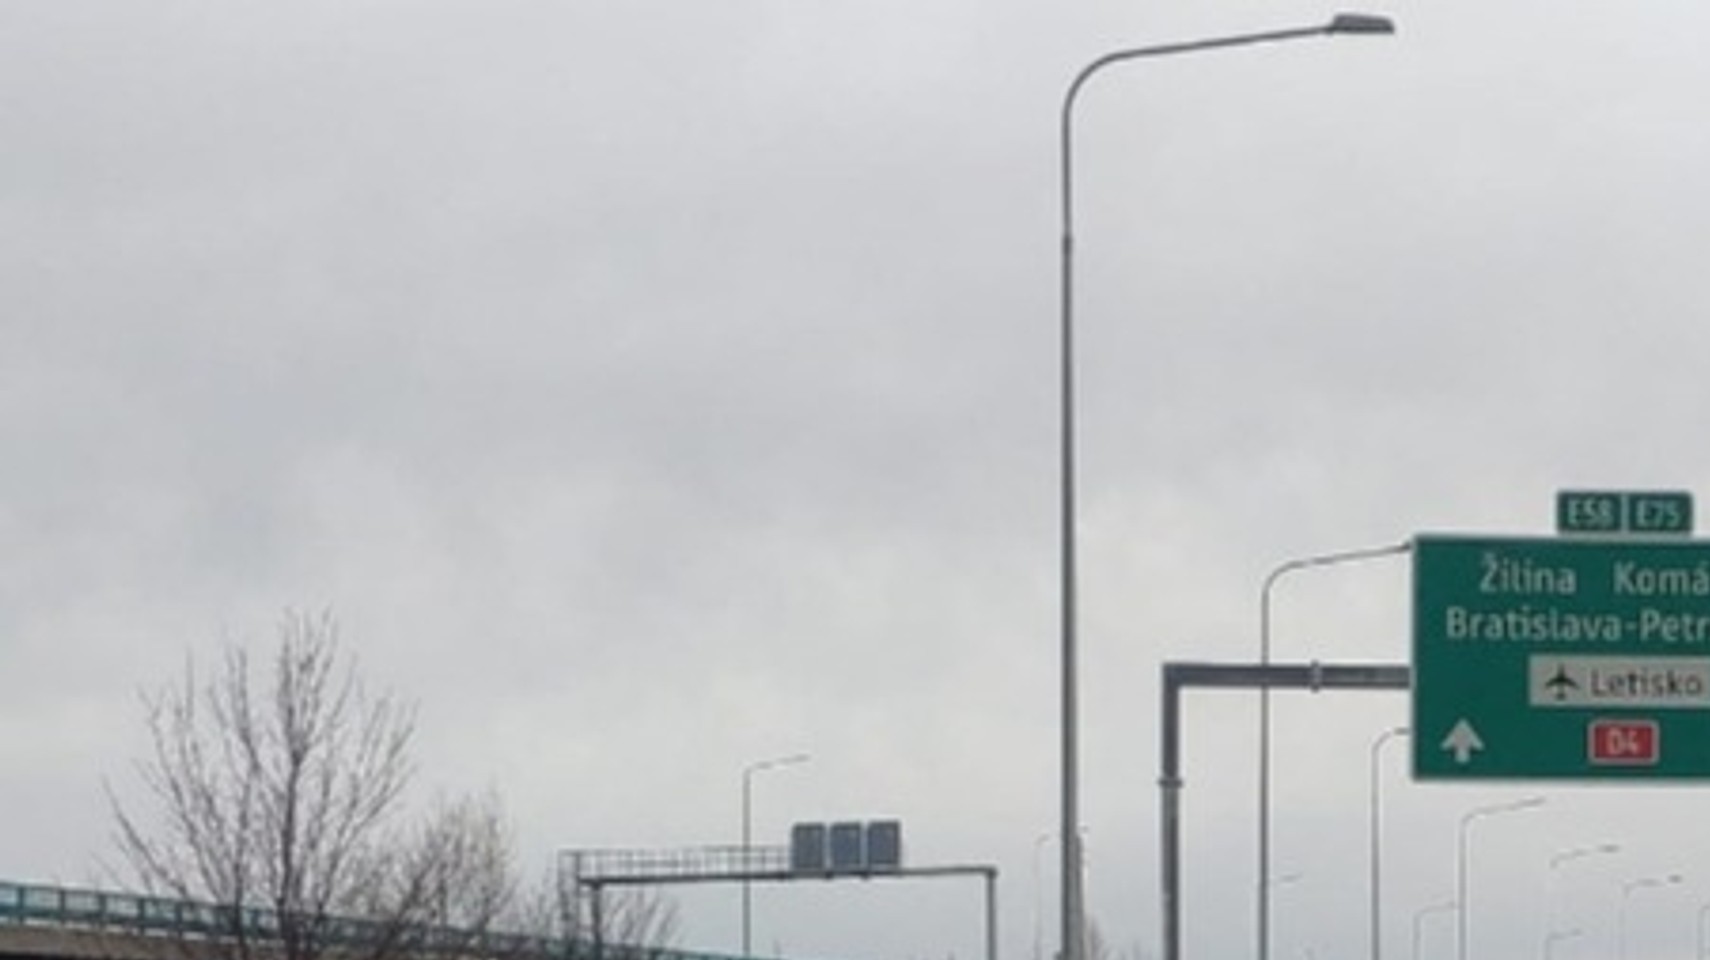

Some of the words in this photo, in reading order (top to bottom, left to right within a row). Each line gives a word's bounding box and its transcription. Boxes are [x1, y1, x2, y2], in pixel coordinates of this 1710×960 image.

[1636, 499, 1682, 528] E75
[1479, 553, 1576, 594] Žilina
[1590, 665, 1704, 697] Letisko
[1605, 728, 1640, 756] D4
